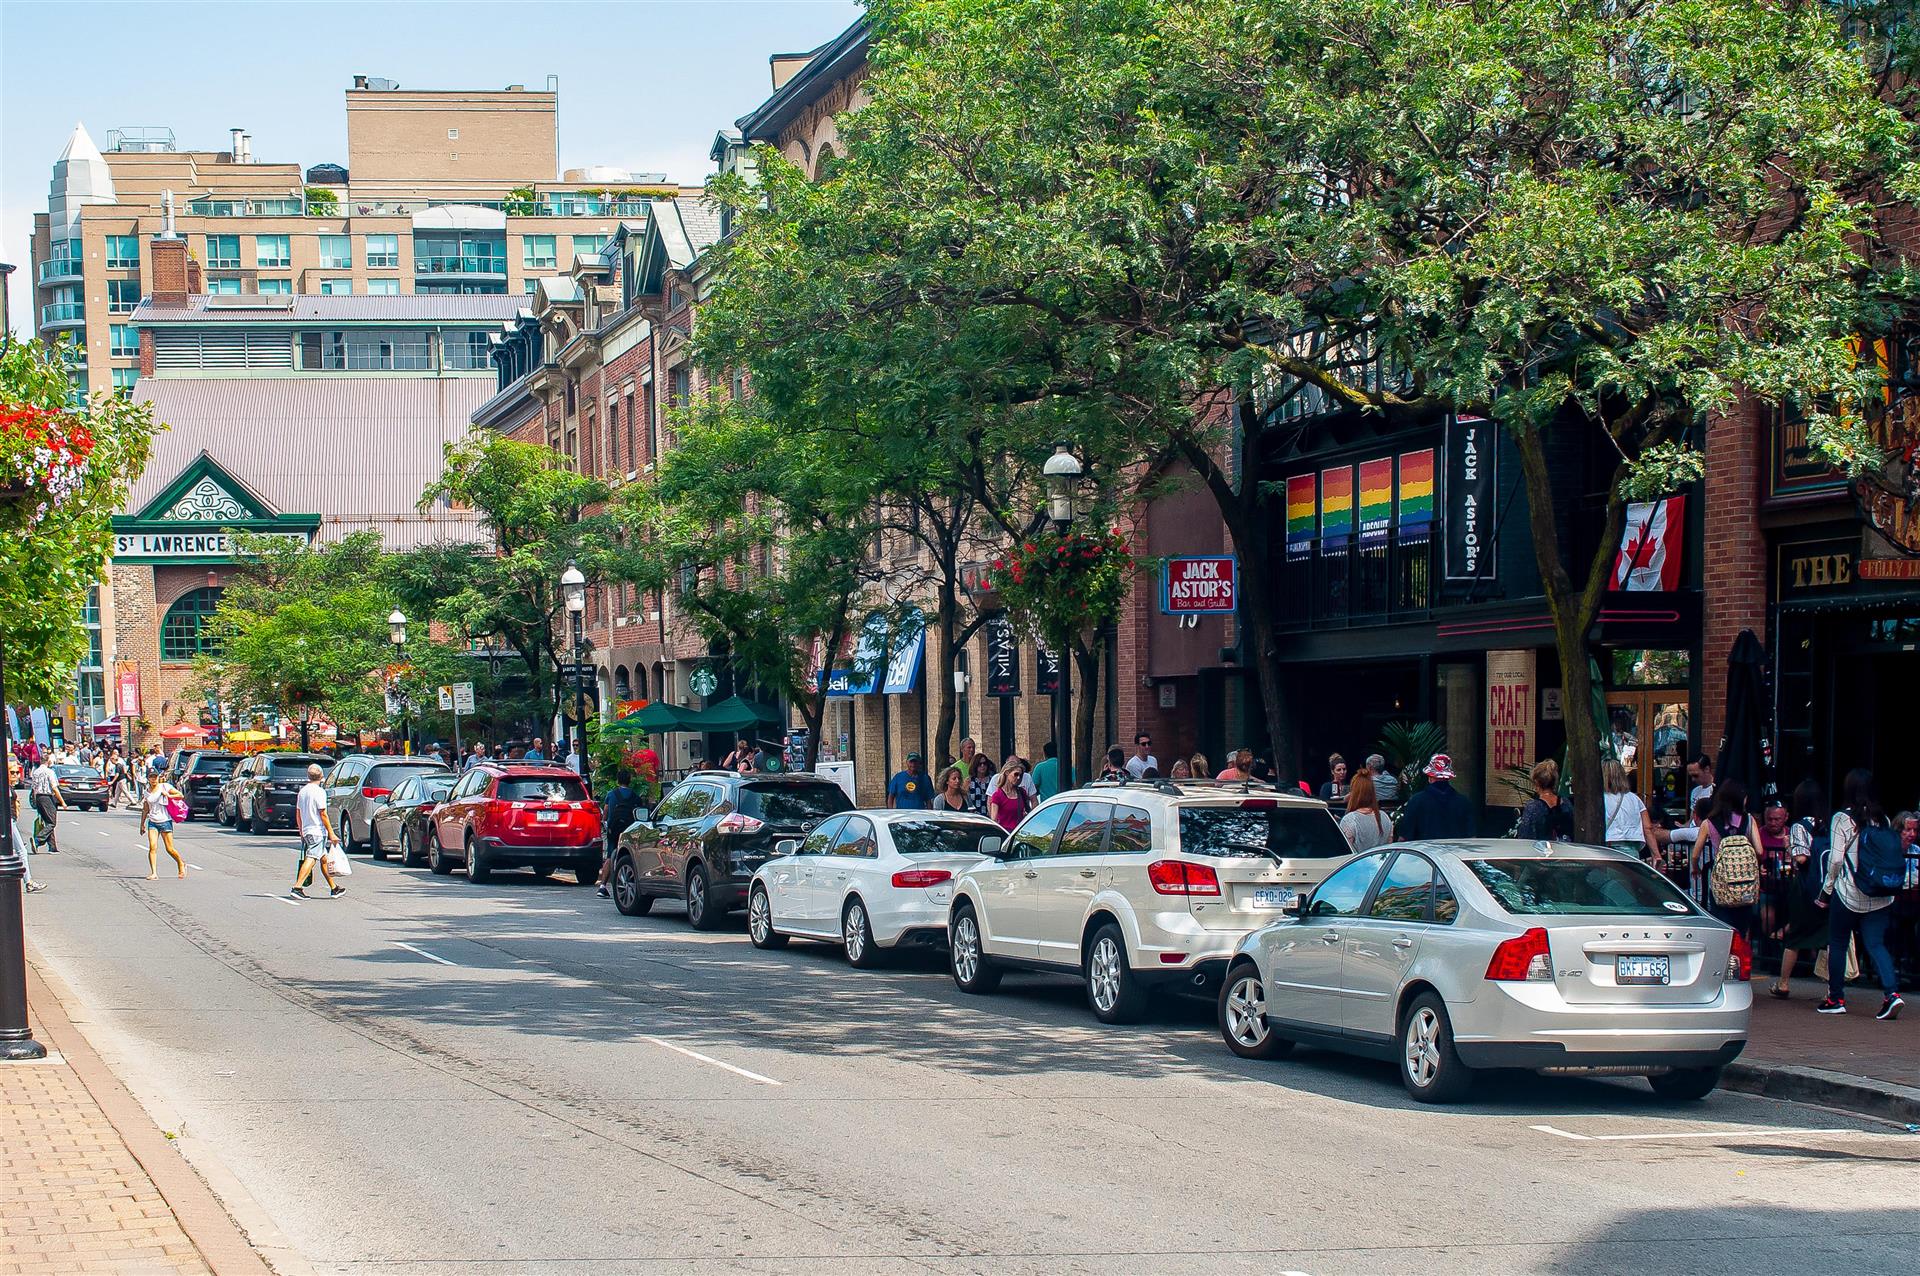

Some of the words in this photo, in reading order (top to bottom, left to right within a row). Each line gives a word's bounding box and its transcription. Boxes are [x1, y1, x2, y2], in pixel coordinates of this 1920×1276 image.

[1464, 428, 1477, 480] JACK
[142, 536, 226, 552] LAWRENCE
[1464, 494, 1480, 572] ASTOR'S
[1171, 580, 1232, 598] ASTOR'S
[1182, 562, 1219, 579] JACK
[1791, 553, 1851, 588] THE
[996, 628, 1010, 677] MILA'S
[1490, 684, 1530, 726] CRAFT
[1493, 729, 1526, 770] BEER
[1598, 931, 1694, 940] VOLVO
